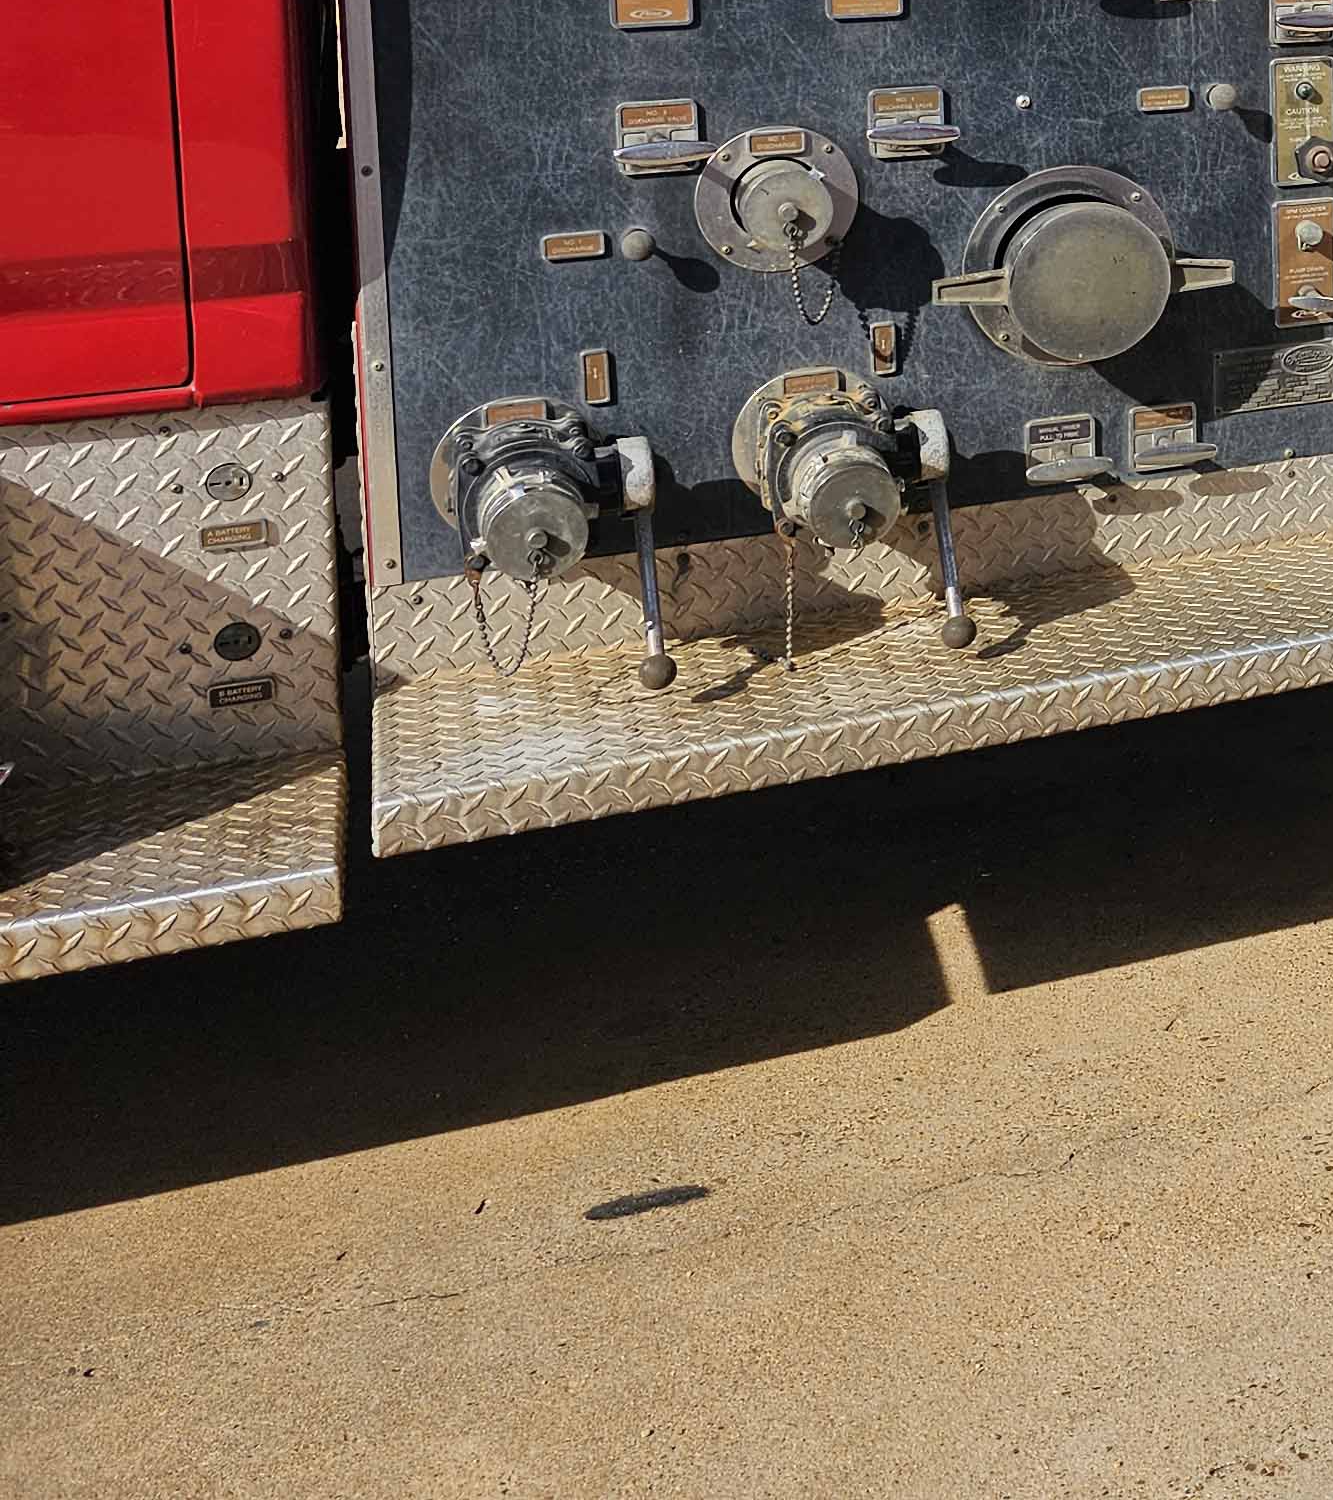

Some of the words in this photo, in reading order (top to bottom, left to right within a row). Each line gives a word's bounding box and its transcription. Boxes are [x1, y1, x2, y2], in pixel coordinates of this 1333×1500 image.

[1283, 65, 1321, 74] WARNING
[1286, 106, 1320, 116] CAUTION
[215, 526, 251, 537] BATTERY
[207, 534, 253, 544] CHARGING
[226, 685, 263, 696] BATTERY
